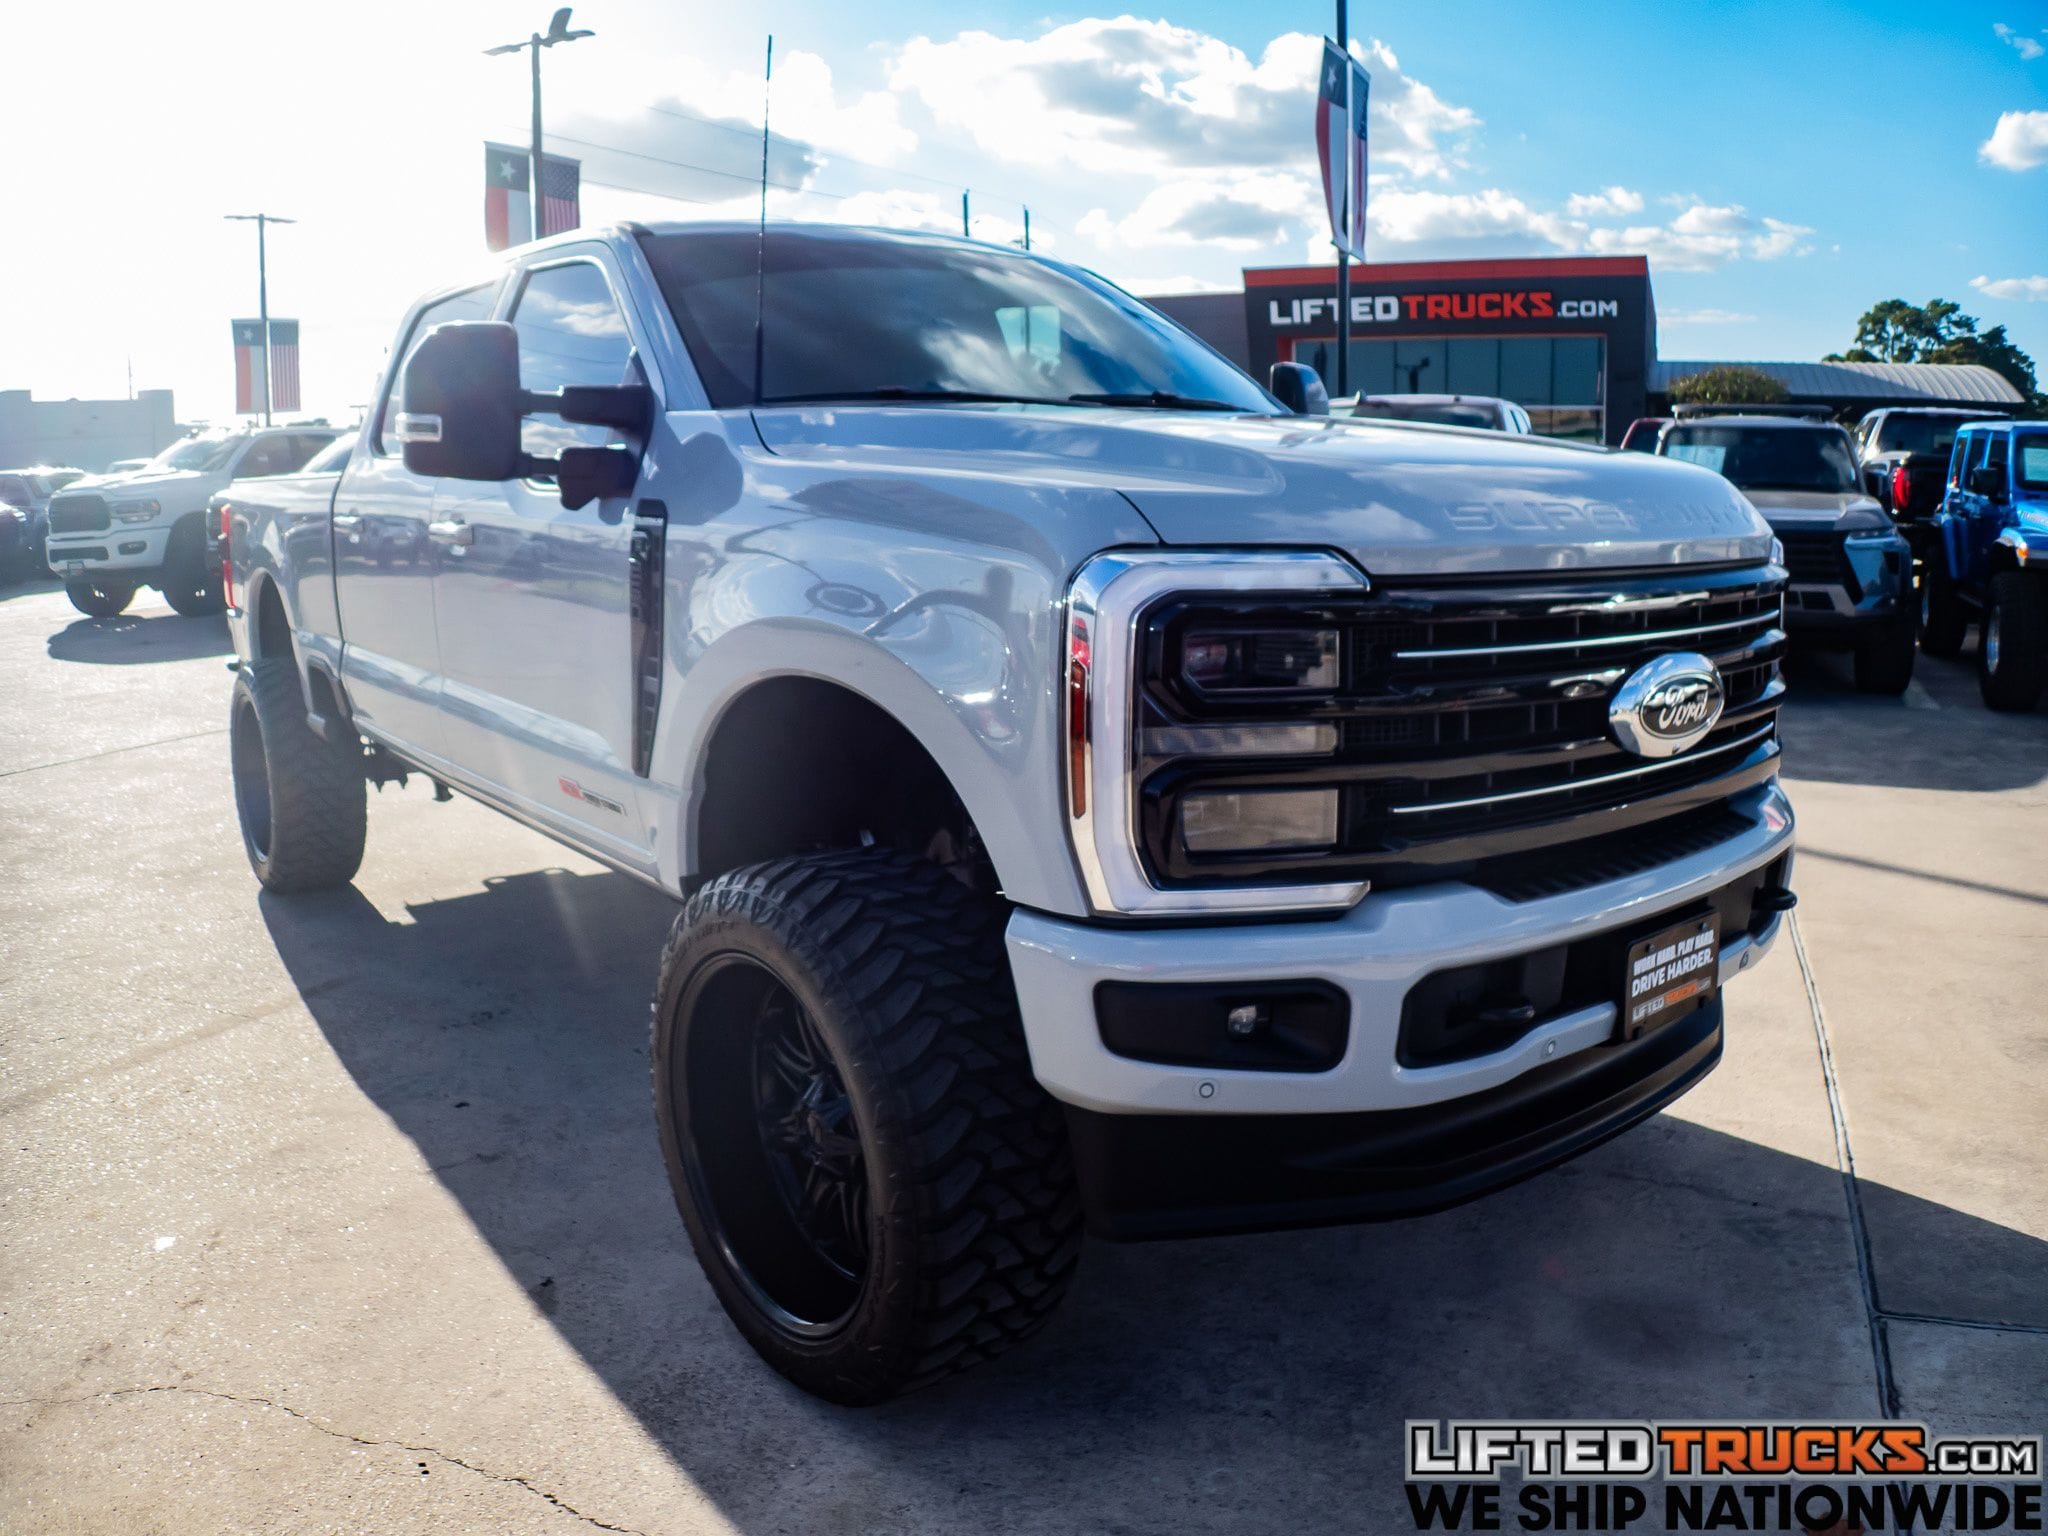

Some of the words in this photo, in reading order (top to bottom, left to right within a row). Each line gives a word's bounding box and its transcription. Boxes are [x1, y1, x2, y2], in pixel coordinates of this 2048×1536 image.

[1658, 682, 1709, 731] Ford
[1631, 967, 1666, 998] DRIVE
[1667, 947, 1714, 981] HARDER.
